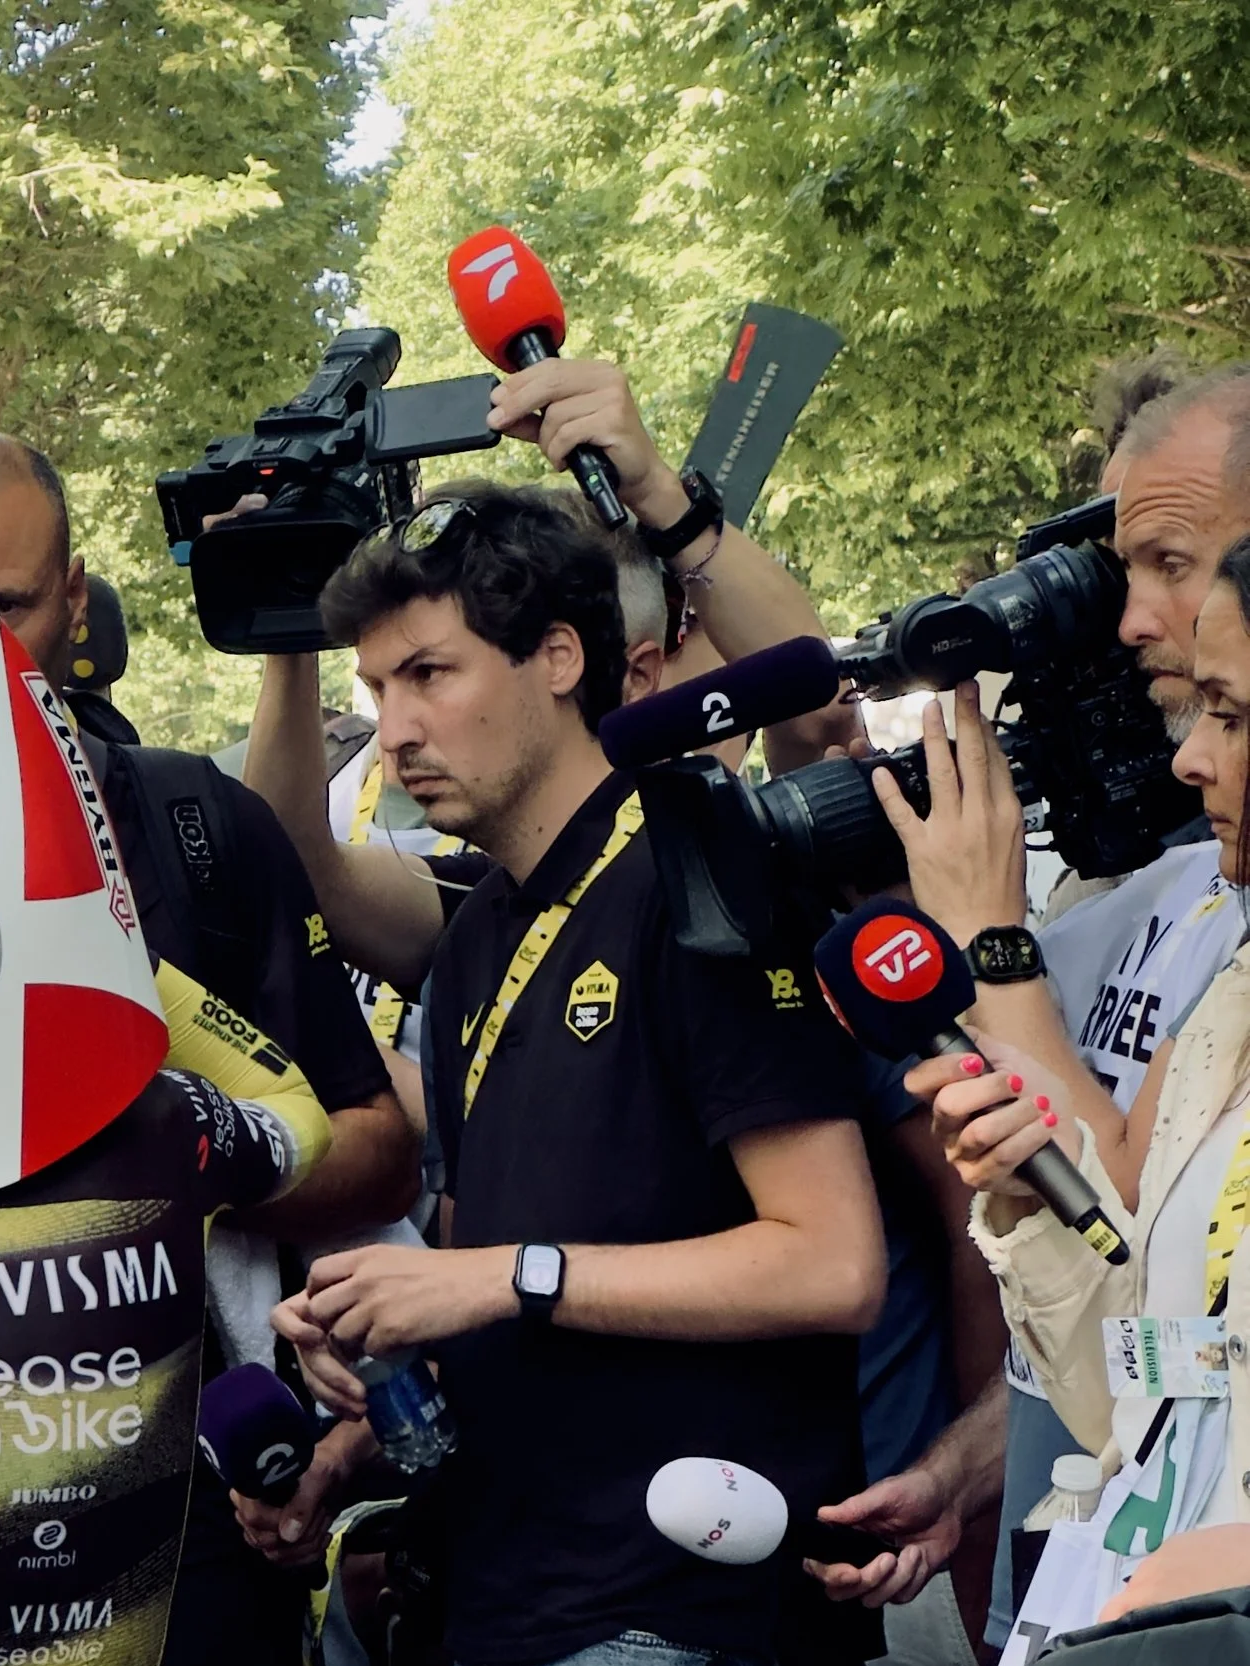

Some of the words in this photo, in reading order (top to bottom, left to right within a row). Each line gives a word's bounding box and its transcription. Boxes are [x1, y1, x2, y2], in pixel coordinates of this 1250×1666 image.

[702, 691, 735, 733] 2
[41, 688, 119, 872] BYGMA
[201, 1000, 258, 1045] FOOD
[256, 1442, 301, 1487] 2
[9, 1485, 97, 1506] JUMBO
[696, 1518, 732, 1550] NOS
[18, 1550, 77, 1569] nimbl
[10, 1598, 113, 1635] VISMA
